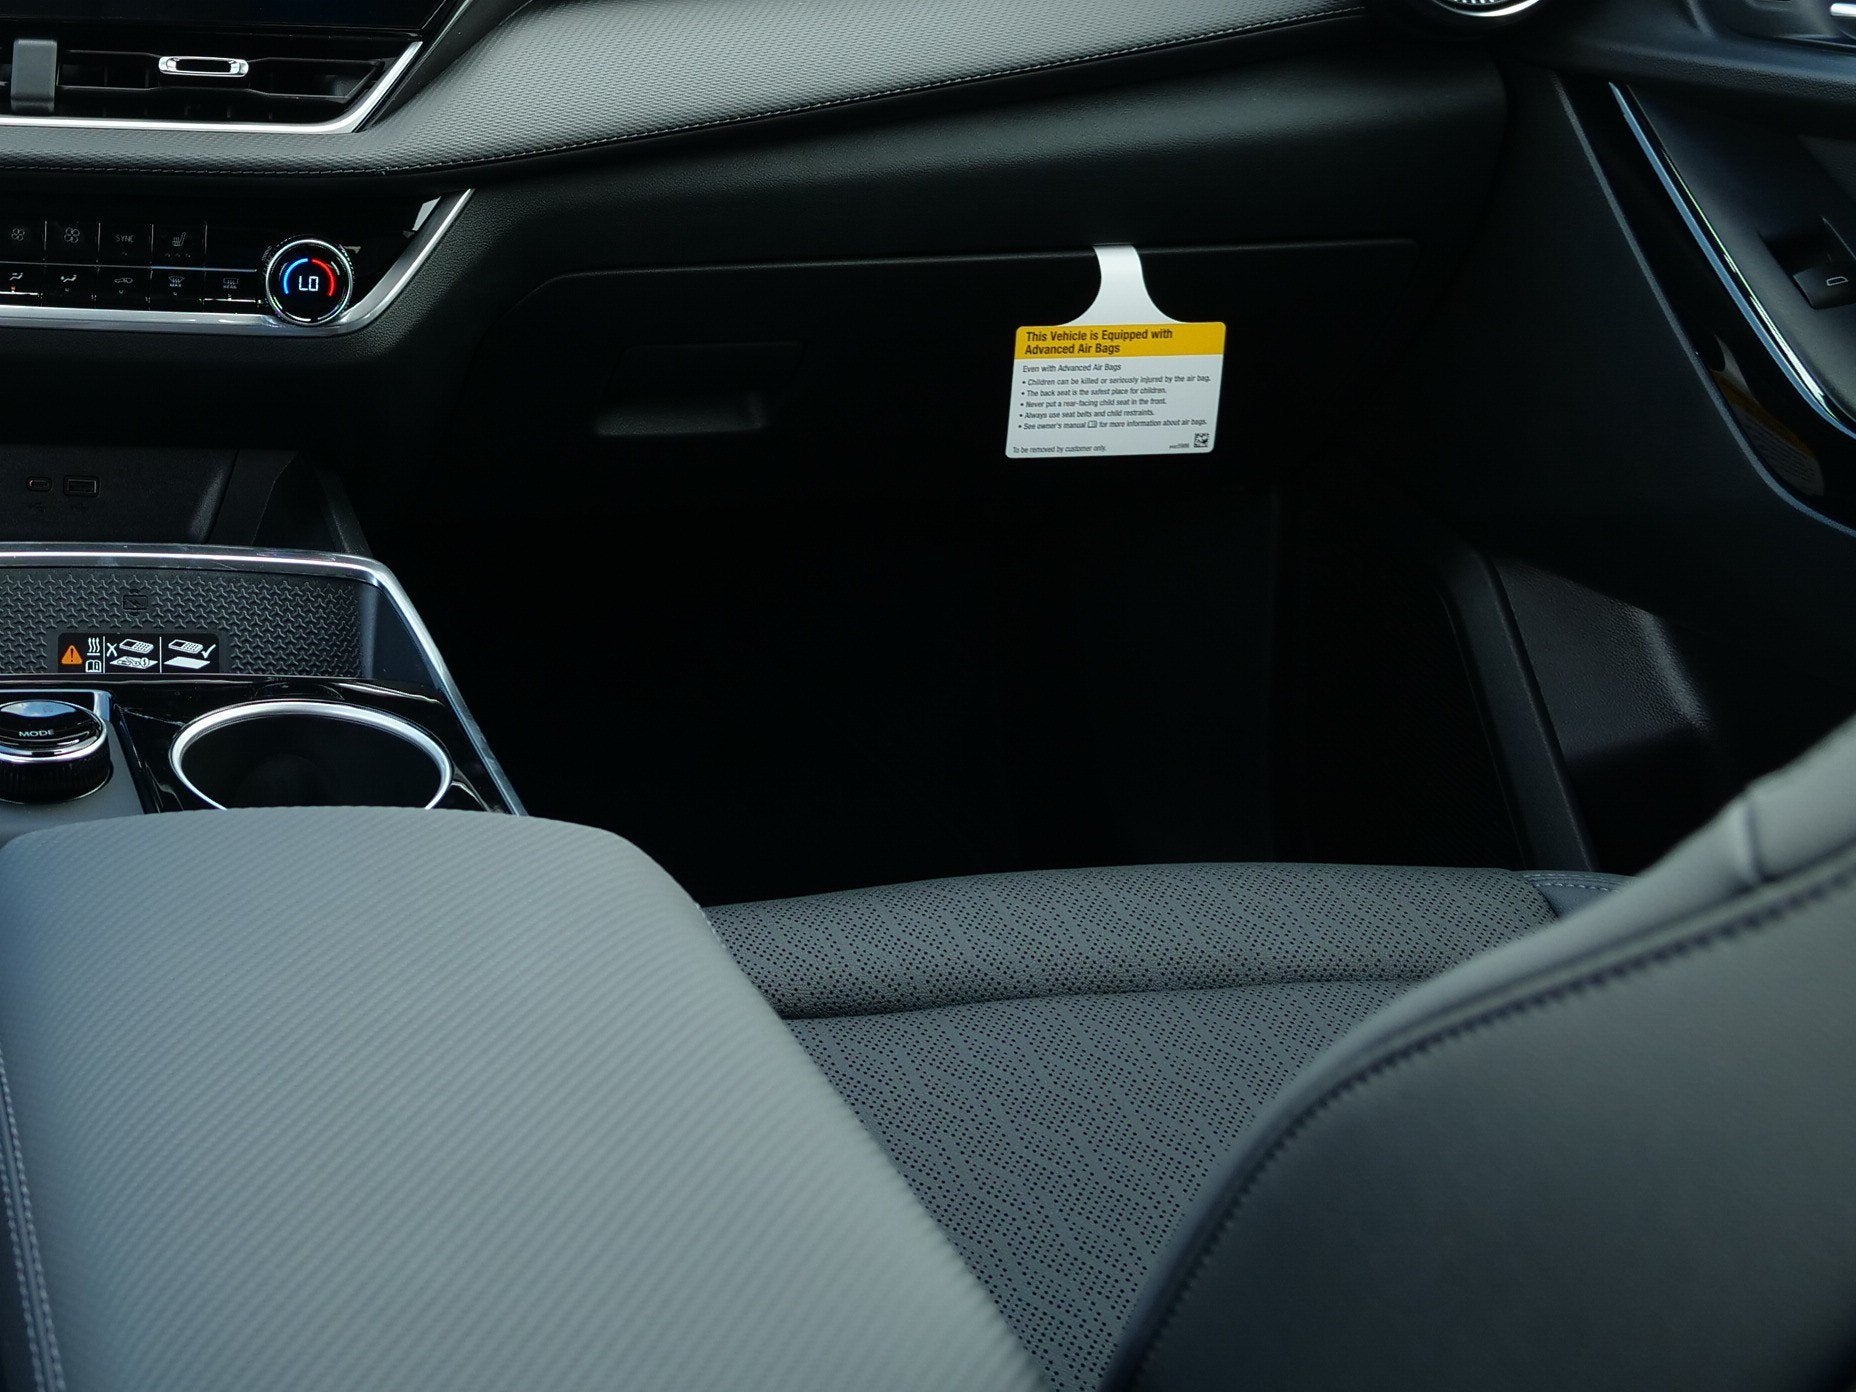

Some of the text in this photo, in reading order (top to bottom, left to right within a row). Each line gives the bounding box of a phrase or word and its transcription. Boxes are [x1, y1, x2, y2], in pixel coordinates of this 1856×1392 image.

[116, 235, 134, 243] SYNC
[299, 276, 319, 291] LO
[1026, 329, 1173, 342] This Vehicle is Equipped with
[1025, 343, 1120, 355] Advanced Air Bags
[1105, 364, 1122, 372] Bags
[1140, 376, 1164, 384] injured
[18, 729, 55, 737] MODE
